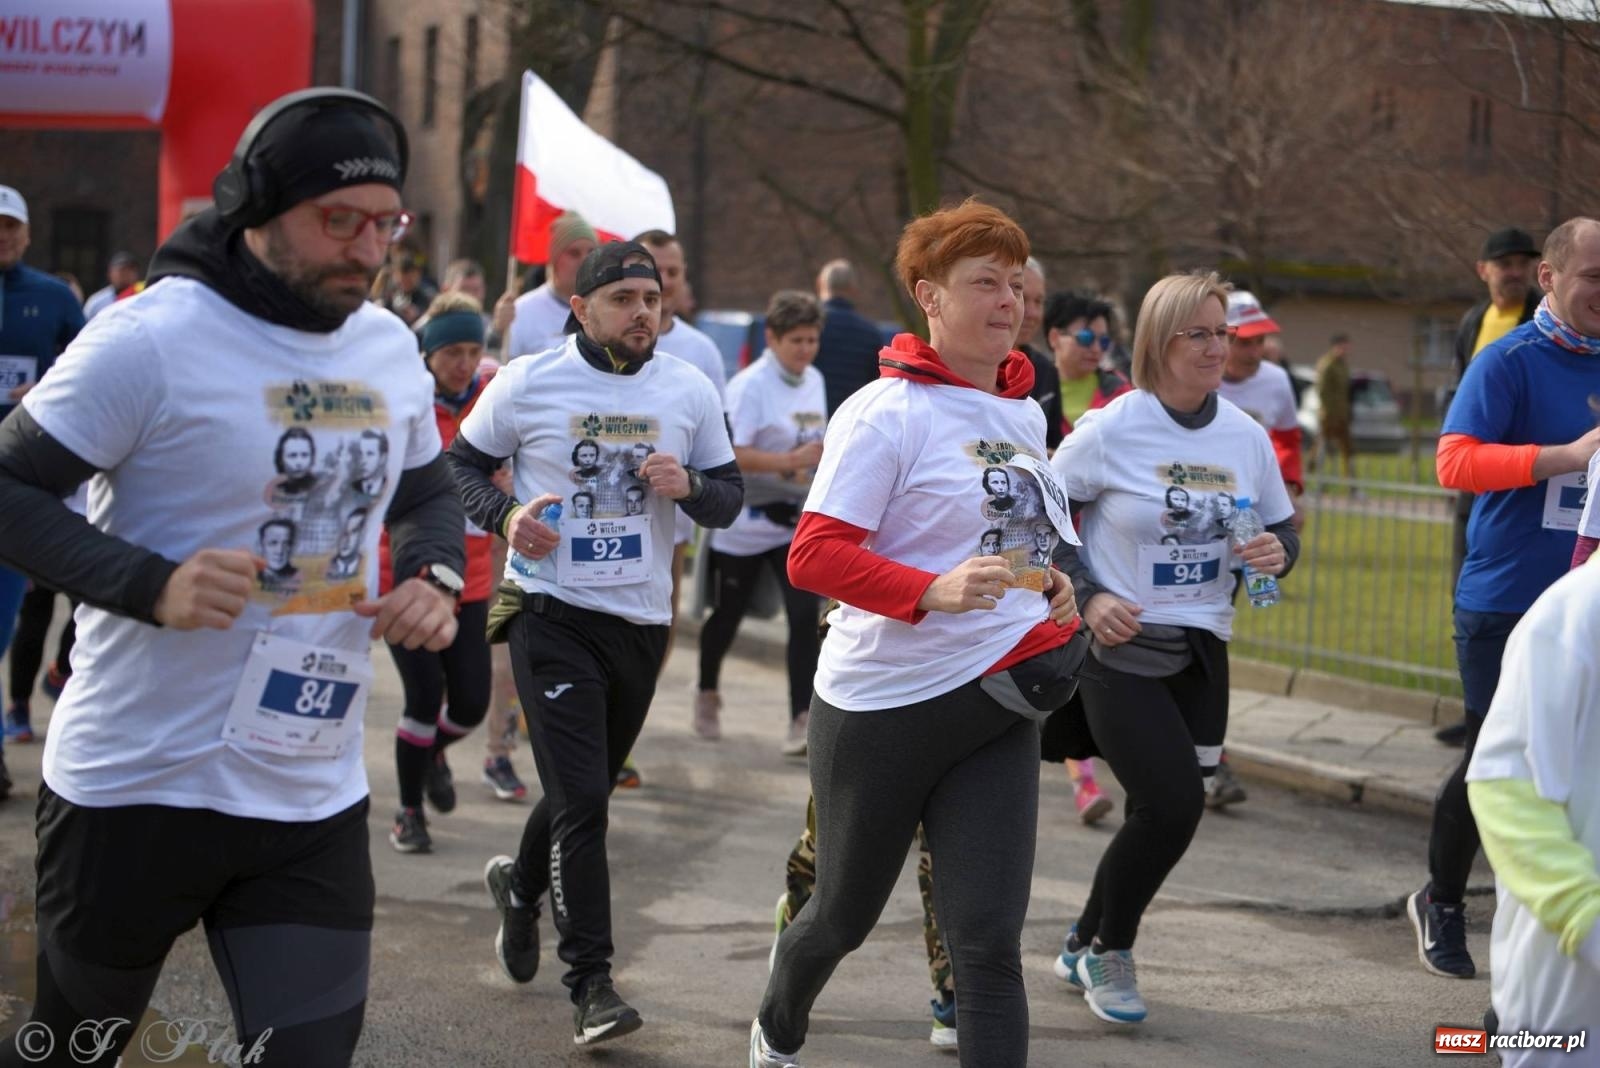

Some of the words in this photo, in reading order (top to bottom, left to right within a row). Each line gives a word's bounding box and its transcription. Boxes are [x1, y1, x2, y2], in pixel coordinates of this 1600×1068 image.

[605, 423, 648, 434] WILCZYM
[592, 537, 623, 560] 92
[1174, 564, 1204, 584] 94
[295, 680, 336, 716] 84
